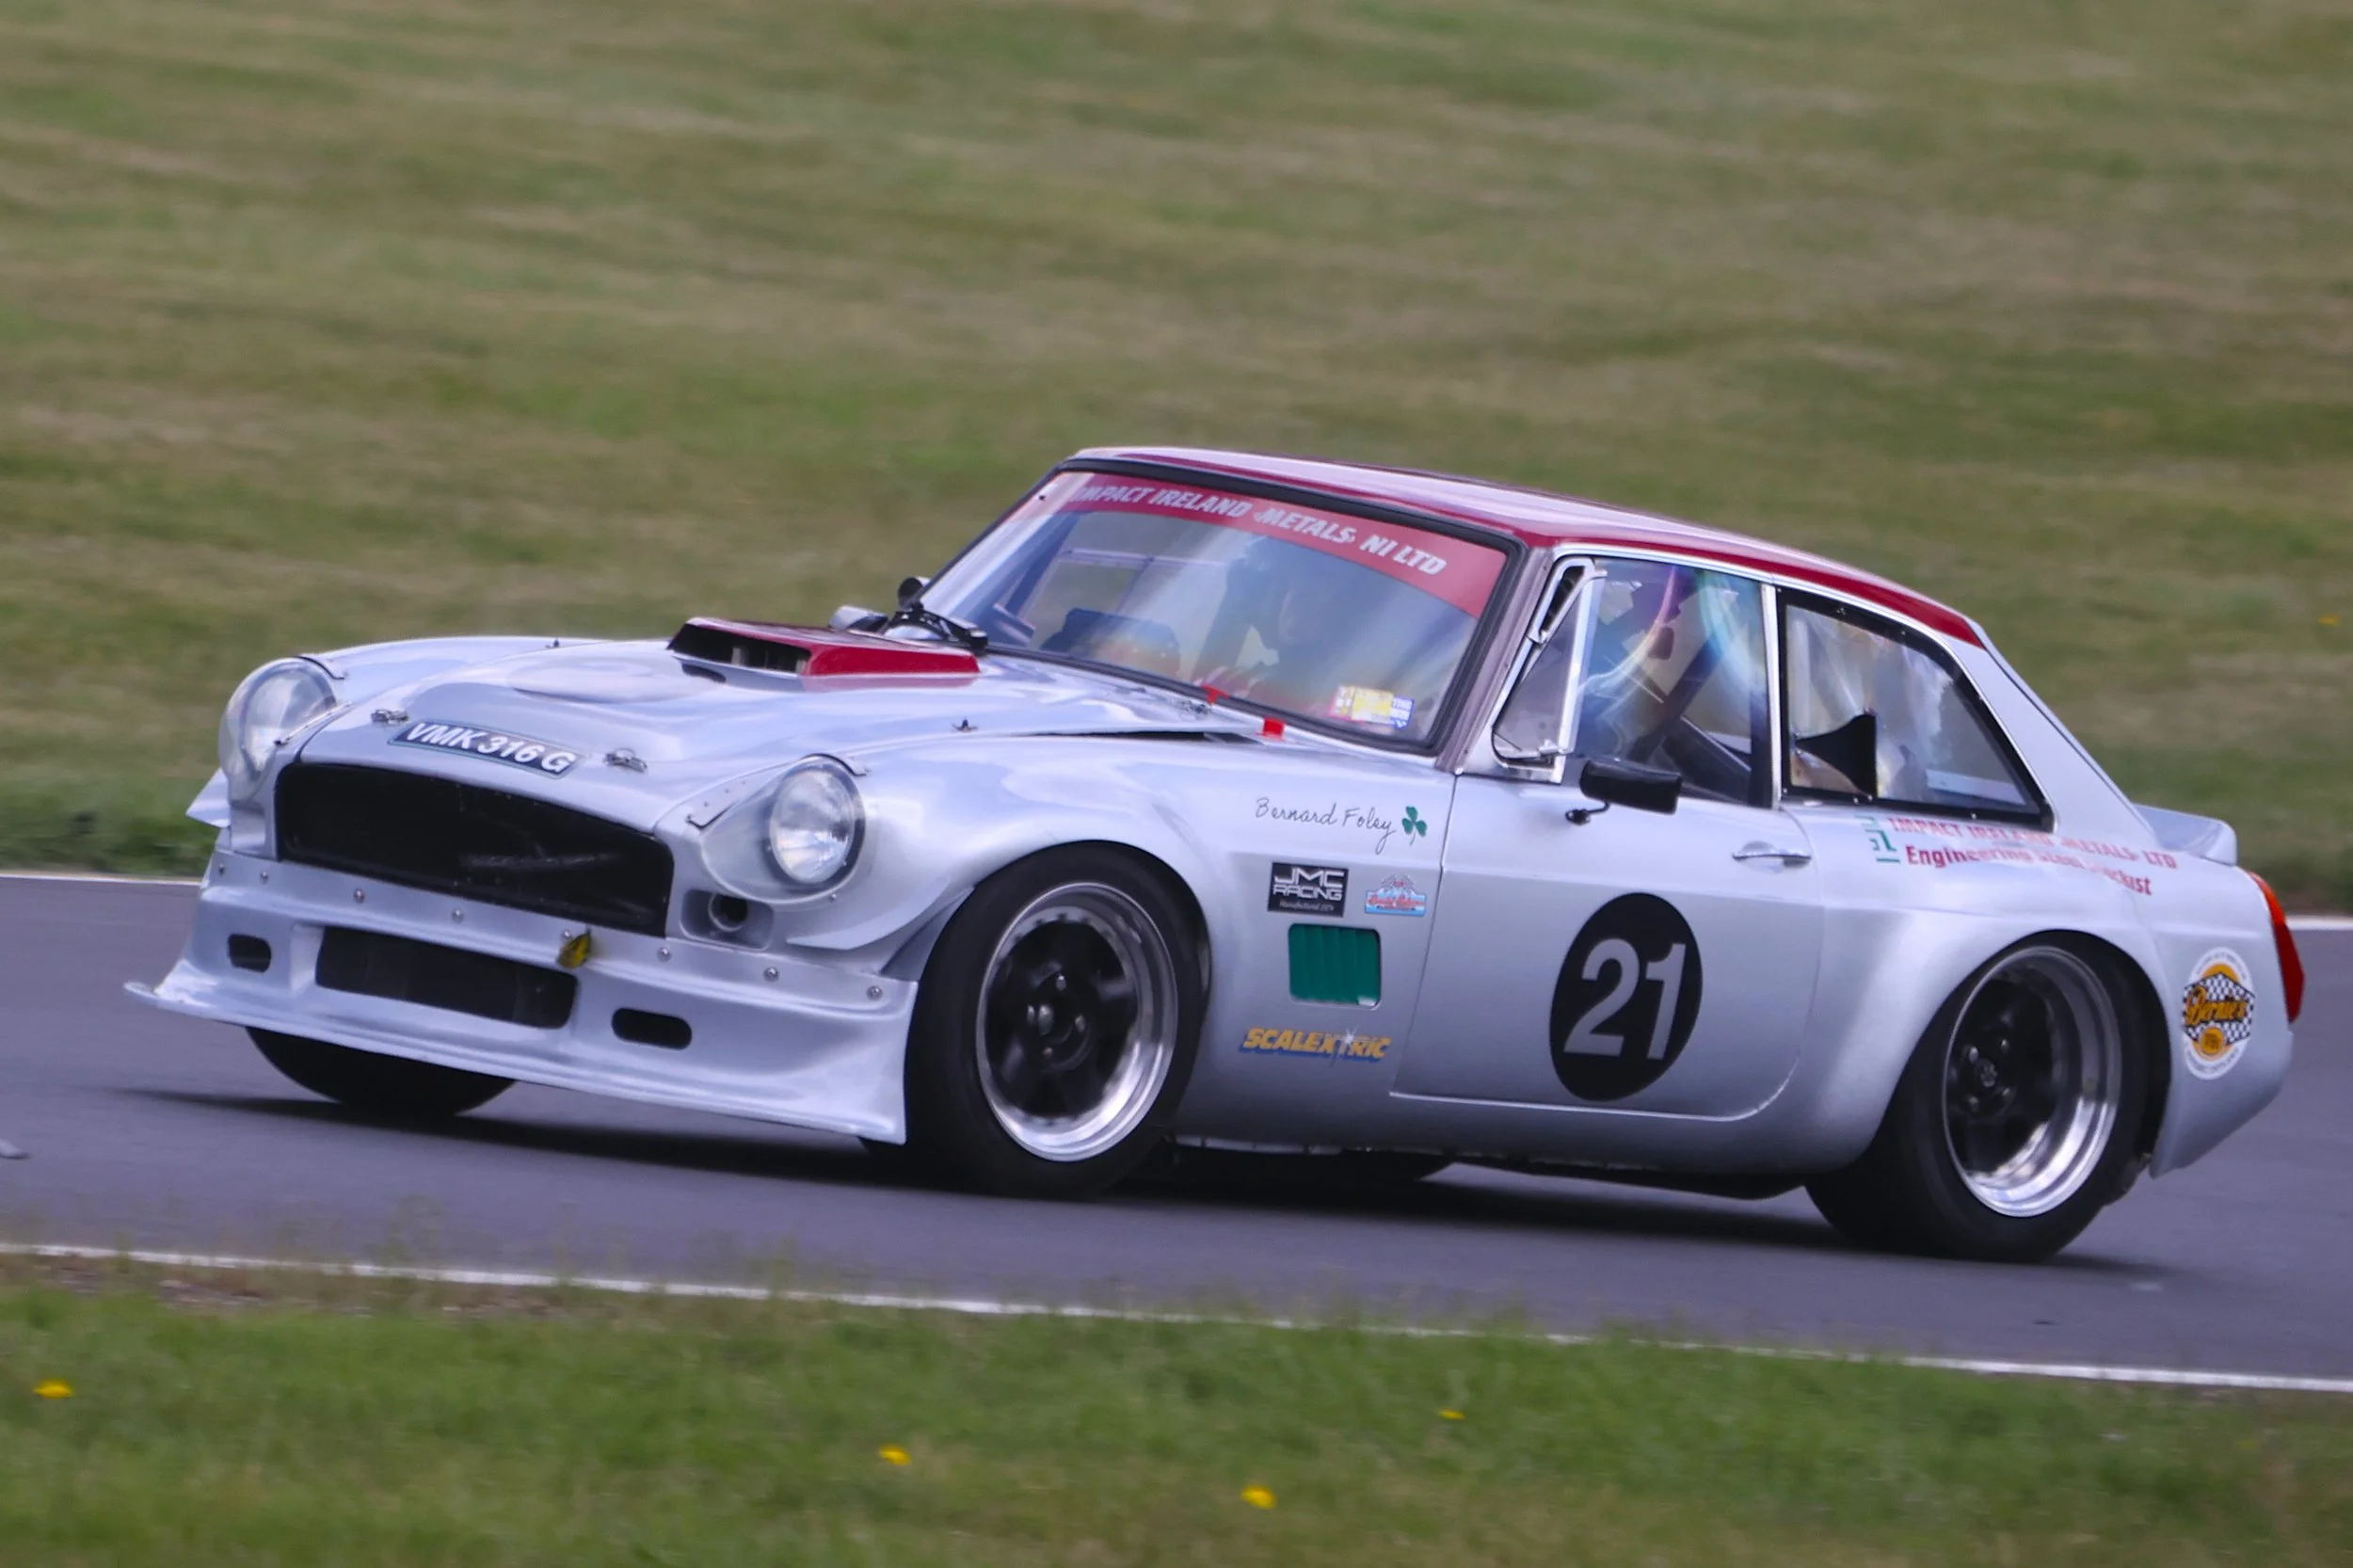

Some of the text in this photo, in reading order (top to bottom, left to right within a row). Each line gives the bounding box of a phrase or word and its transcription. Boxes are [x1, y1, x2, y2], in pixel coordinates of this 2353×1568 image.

[1148, 489, 1253, 518] IRELAND
[1359, 534, 1399, 557] NI
[1392, 546, 1448, 575] LTD
[407, 723, 576, 773] VMK 316 G
[1256, 796, 1397, 856] Bernard Foley
[1887, 817, 1963, 837] IMPACT
[2142, 850, 2178, 870] LTD
[1273, 884, 1344, 902] RACING
[1274, 868, 1345, 888] JMC
[1563, 938, 1687, 1060] 21
[1240, 1027, 1392, 1063] SCALEXTRIC
